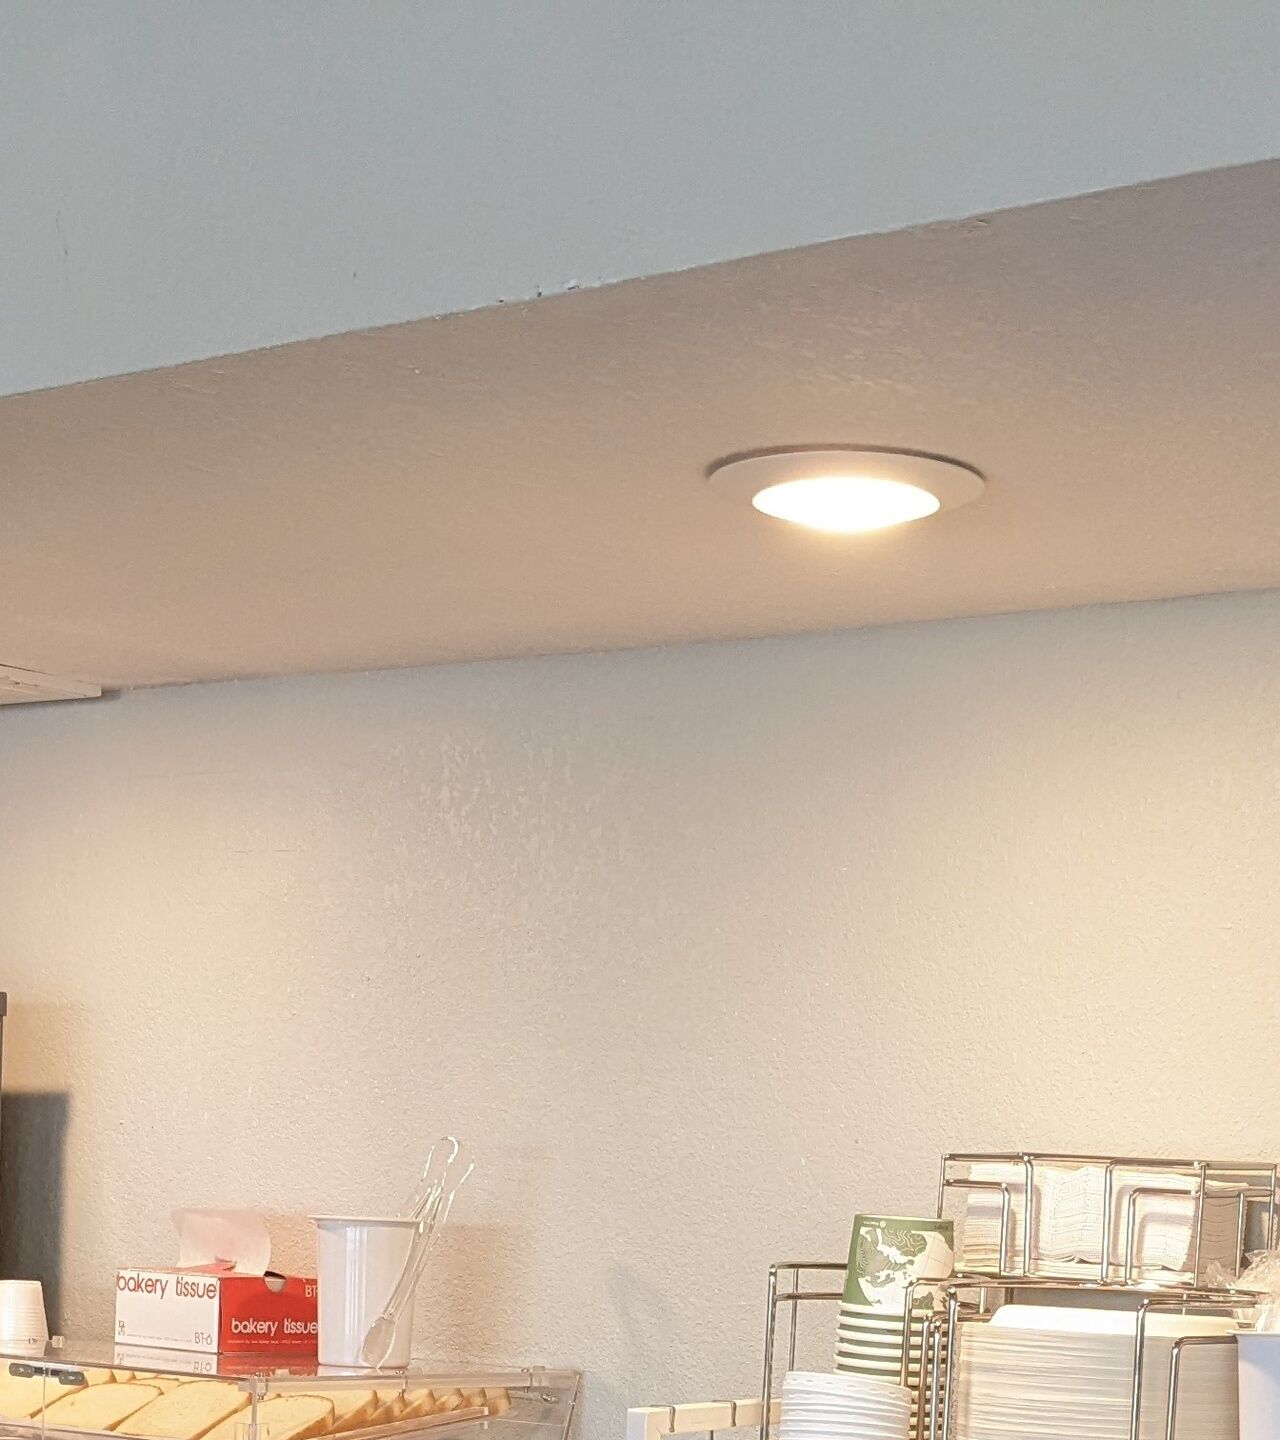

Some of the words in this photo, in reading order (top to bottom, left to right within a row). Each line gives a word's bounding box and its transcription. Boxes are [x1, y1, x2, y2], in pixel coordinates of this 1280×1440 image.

[117, 1272, 168, 1299] bakery
[175, 1275, 216, 1299] tissue
[231, 1318, 278, 1336] bakery
[283, 1318, 317, 1334] tissue
[194, 1331, 213, 1345] BT-6
